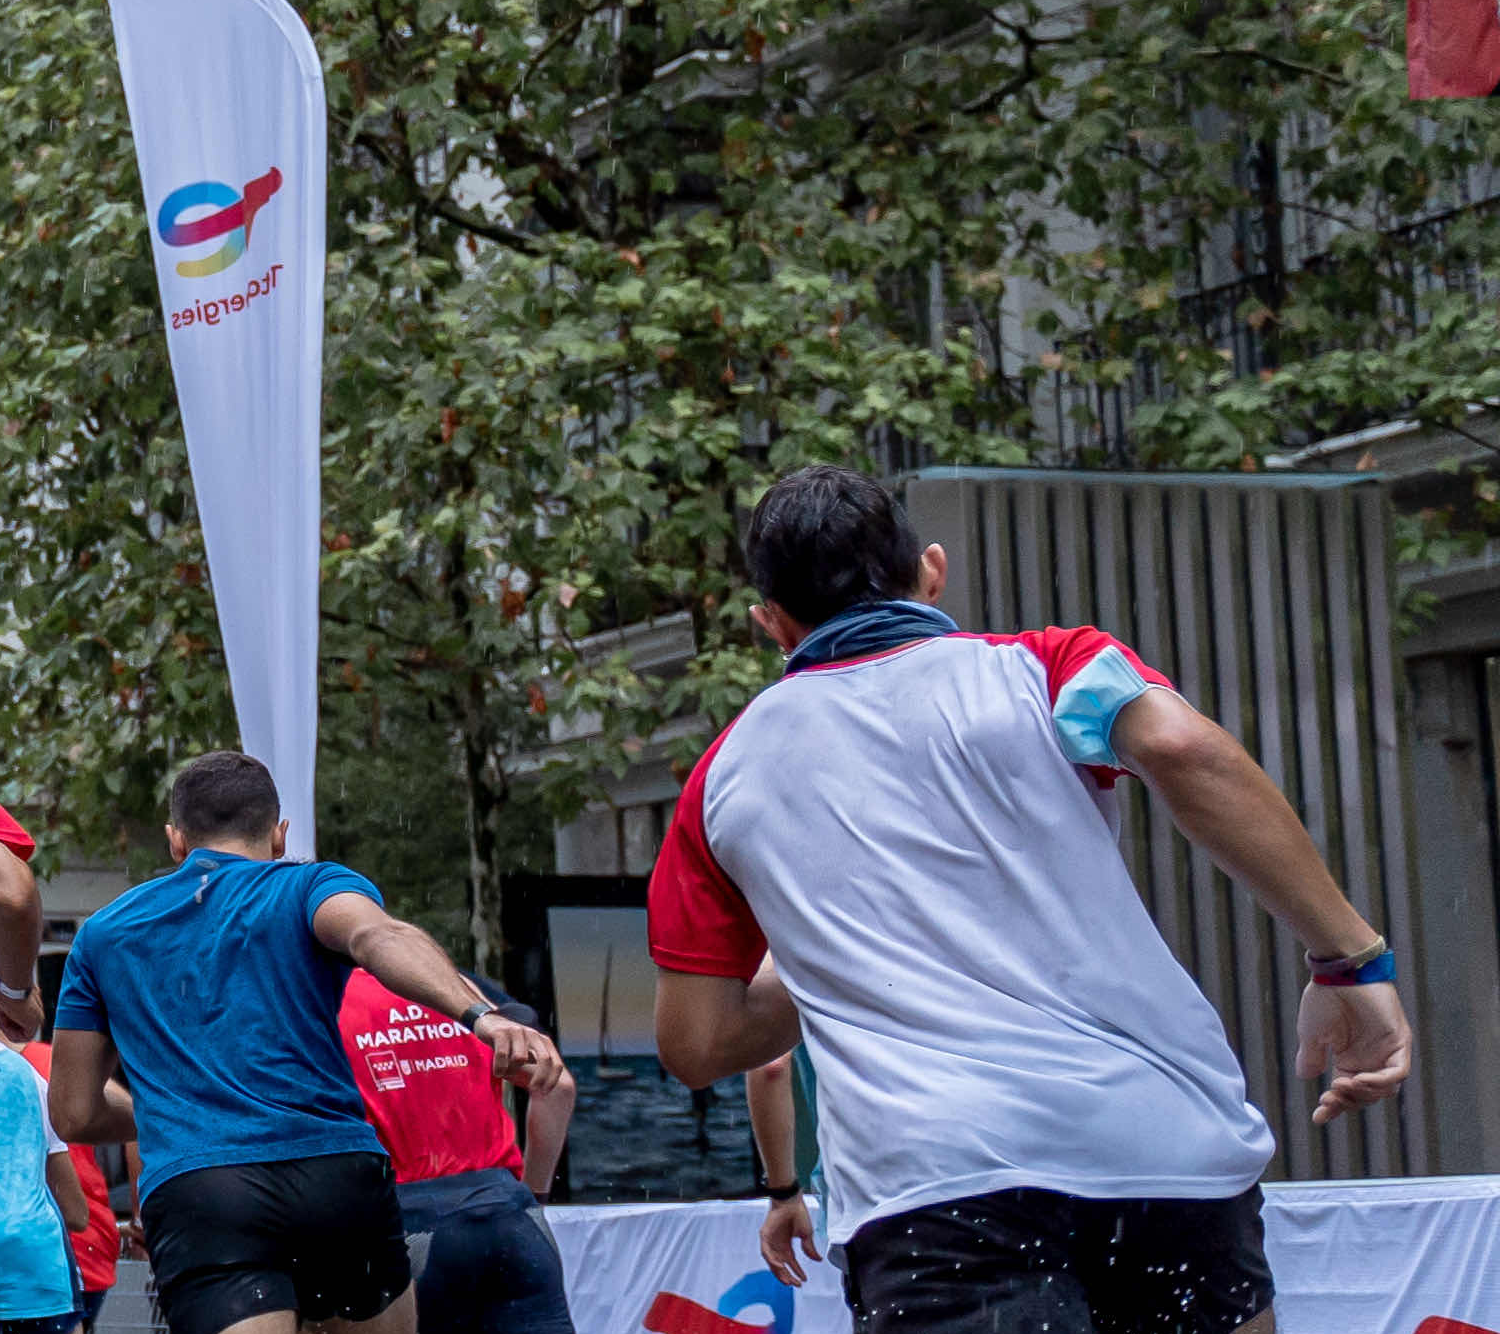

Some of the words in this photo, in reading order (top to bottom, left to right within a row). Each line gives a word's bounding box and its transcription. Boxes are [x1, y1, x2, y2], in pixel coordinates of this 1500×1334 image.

[388, 1004, 430, 1024] A.D.
[355, 1020, 471, 1050] MARATHON
[414, 1054, 469, 1072] MADRID
